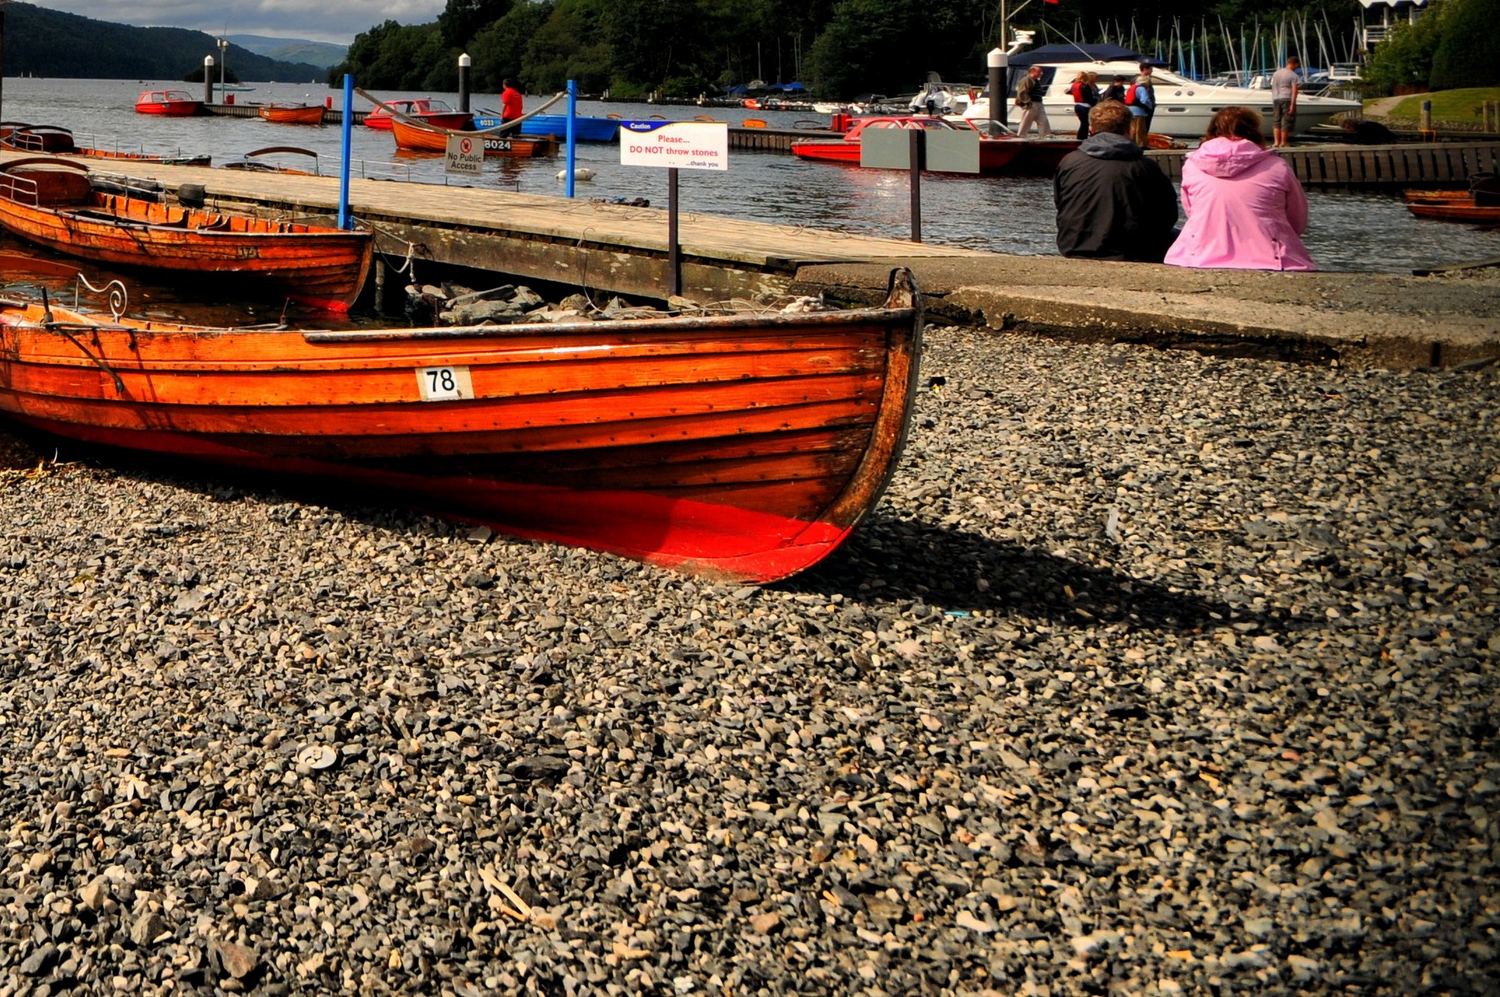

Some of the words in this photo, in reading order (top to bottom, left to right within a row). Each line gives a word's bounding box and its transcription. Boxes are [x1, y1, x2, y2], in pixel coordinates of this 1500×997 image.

[484, 140, 511, 149] 8024
[629, 145, 642, 153] DO
[645, 146, 664, 154] NOT
[666, 147, 689, 155] throw
[691, 149, 718, 157] stones
[448, 152, 457, 161] No
[459, 153, 481, 163] Public
[450, 161, 477, 171] Access
[426, 369, 455, 393] 78
